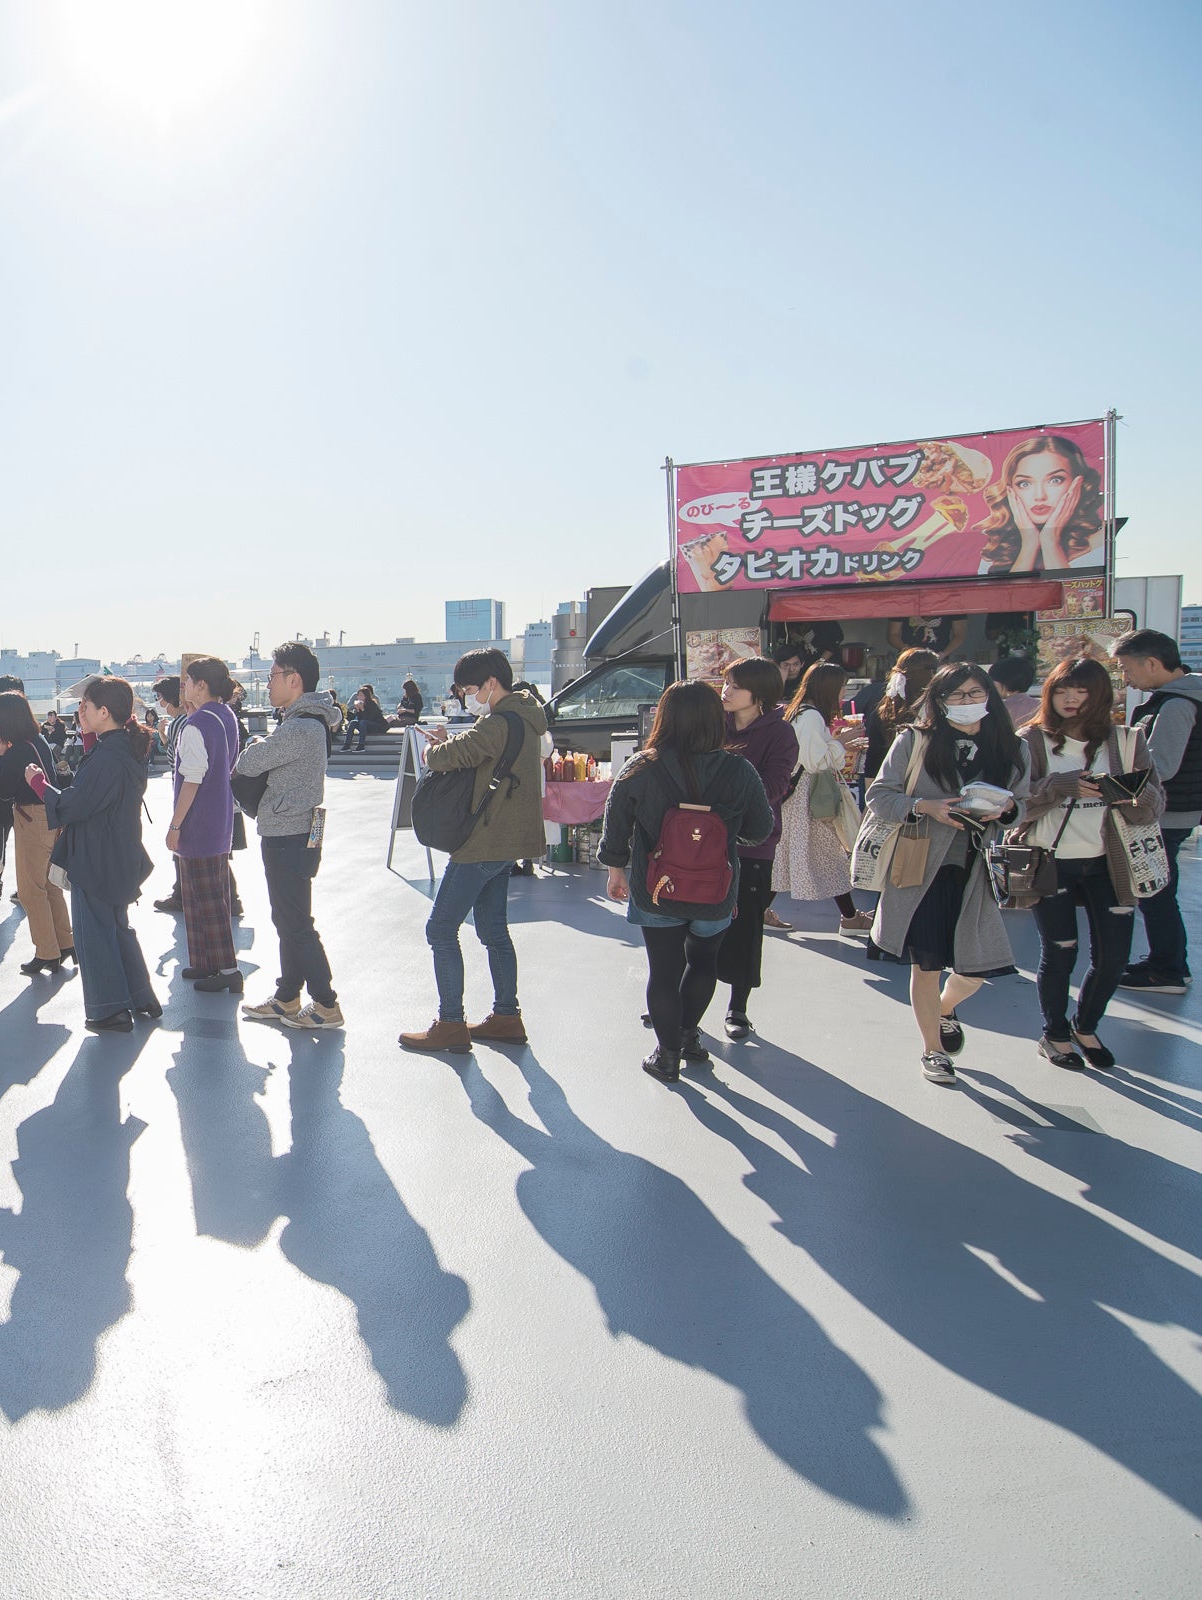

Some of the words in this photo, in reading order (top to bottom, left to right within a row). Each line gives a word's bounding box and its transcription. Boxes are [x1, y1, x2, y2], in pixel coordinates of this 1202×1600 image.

[751, 452, 922, 499] 王様ケバブ
[741, 496, 922, 541] チーズドッグ
